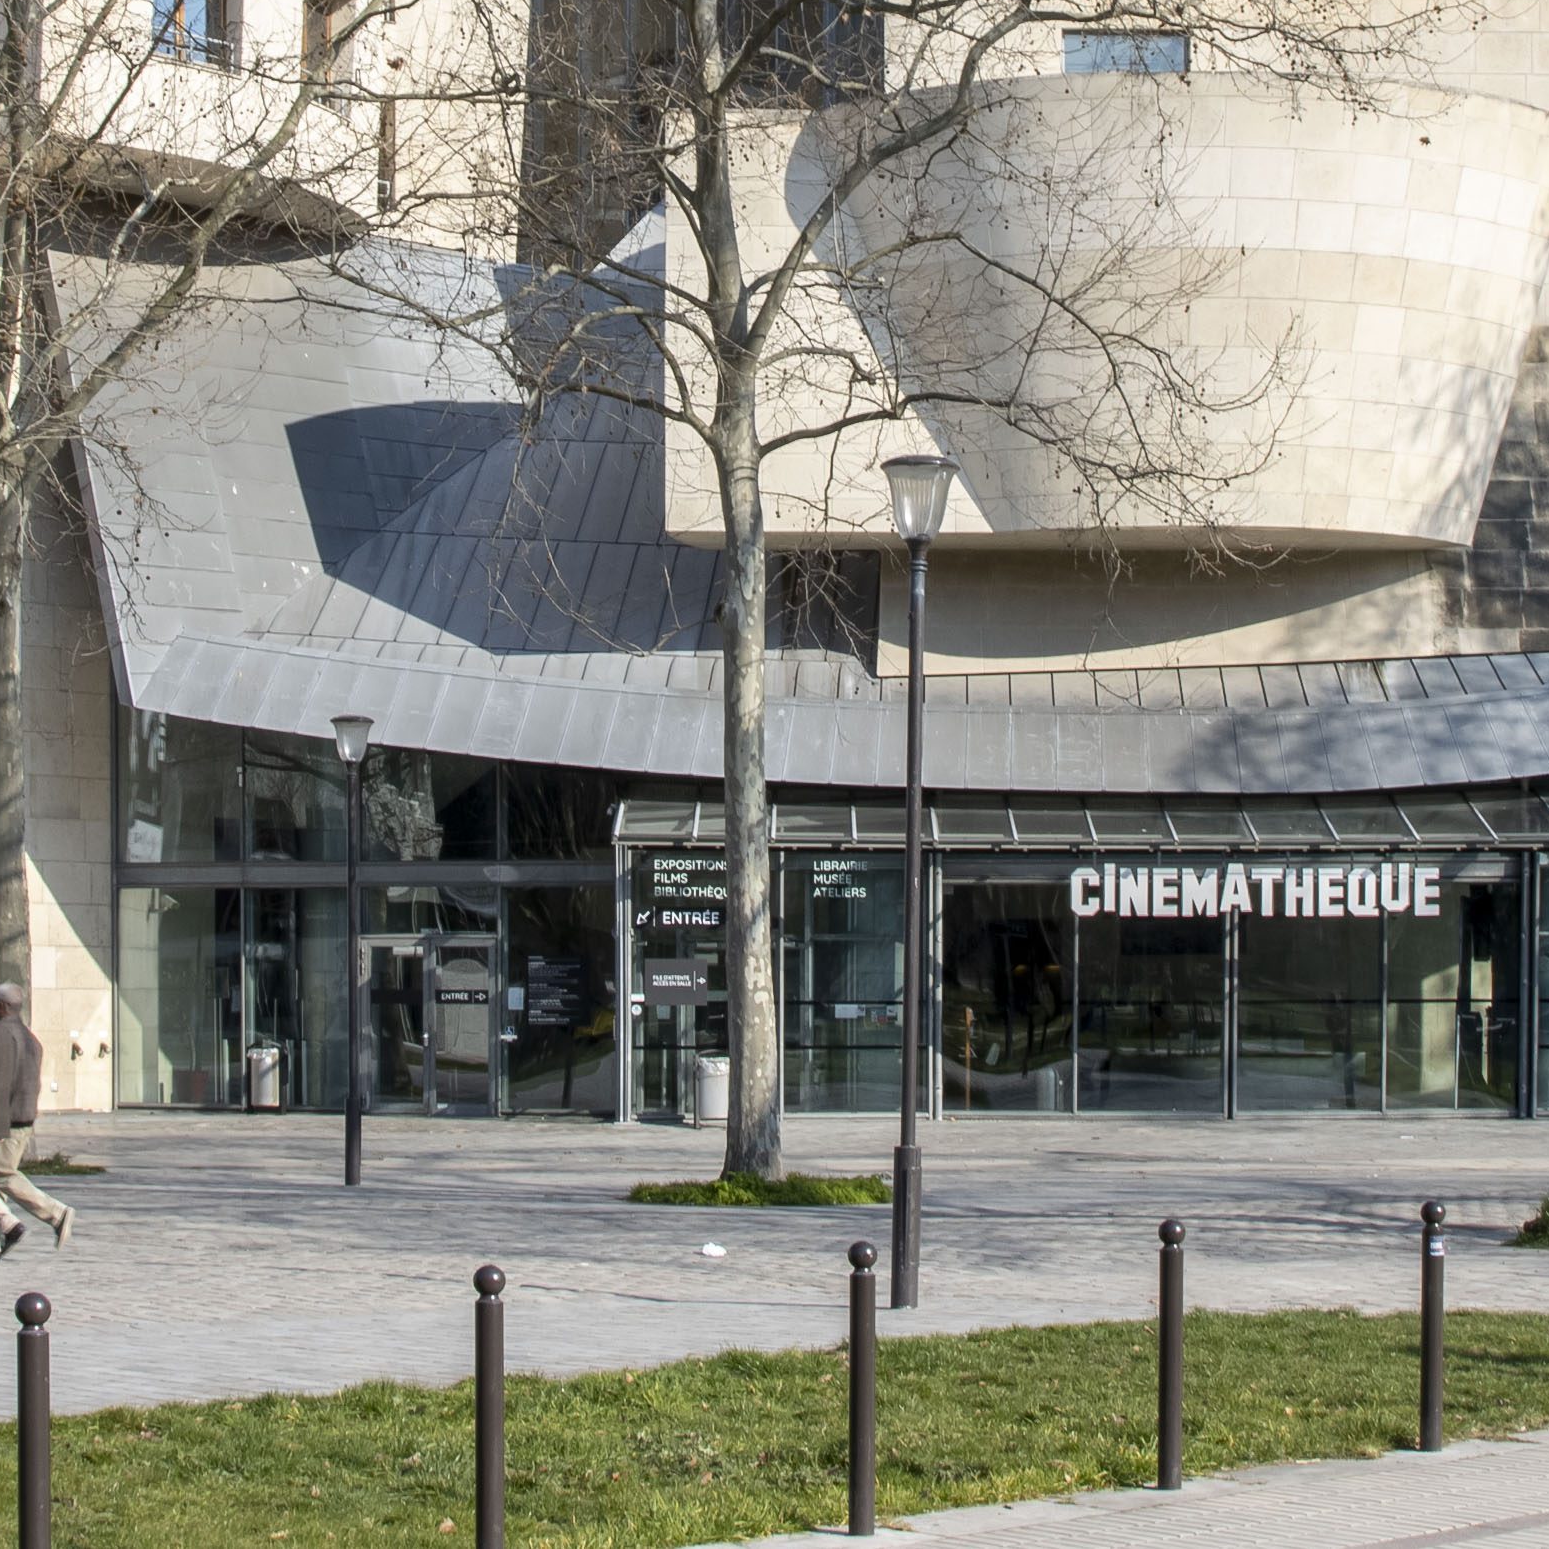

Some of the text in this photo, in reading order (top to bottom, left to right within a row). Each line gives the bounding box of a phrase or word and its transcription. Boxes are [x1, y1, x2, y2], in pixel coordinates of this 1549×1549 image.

[813, 860, 868, 871] LIBRAIRIE
[653, 872, 688, 884] FILMS
[813, 872, 852, 885] MUSÉE
[654, 885, 728, 900] BIBLIOTHÈQU
[813, 887, 867, 898] ATELIERS
[1070, 862, 1441, 918] CINEMATHEQUE
[662, 909, 720, 925] ENTRÉE
[441, 991, 469, 1001] ENTRÉE
